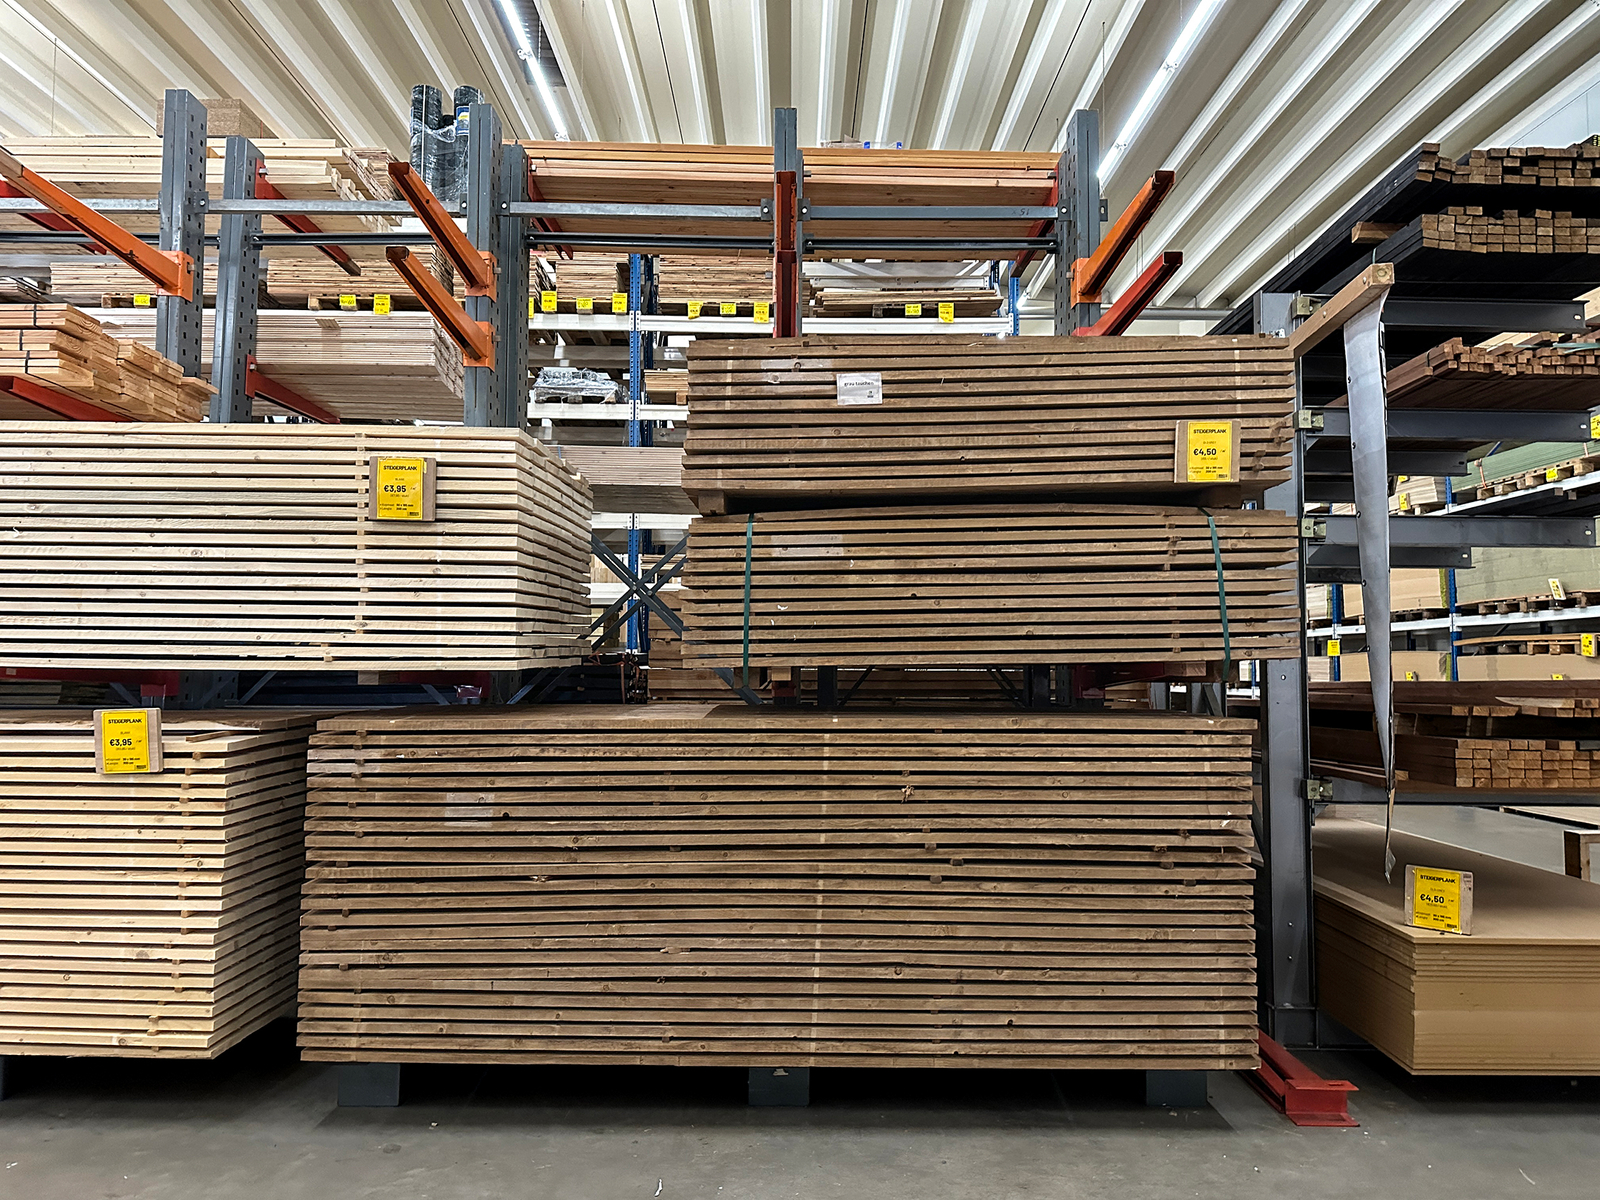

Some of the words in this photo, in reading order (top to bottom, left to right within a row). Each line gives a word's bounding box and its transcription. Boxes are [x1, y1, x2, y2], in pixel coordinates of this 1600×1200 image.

[1193, 448, 1217, 456] €4,50
[384, 484, 407, 493] €3,95
[109, 738, 132, 747] €3,95
[1420, 874, 1456, 884] STEIGERPLANK
